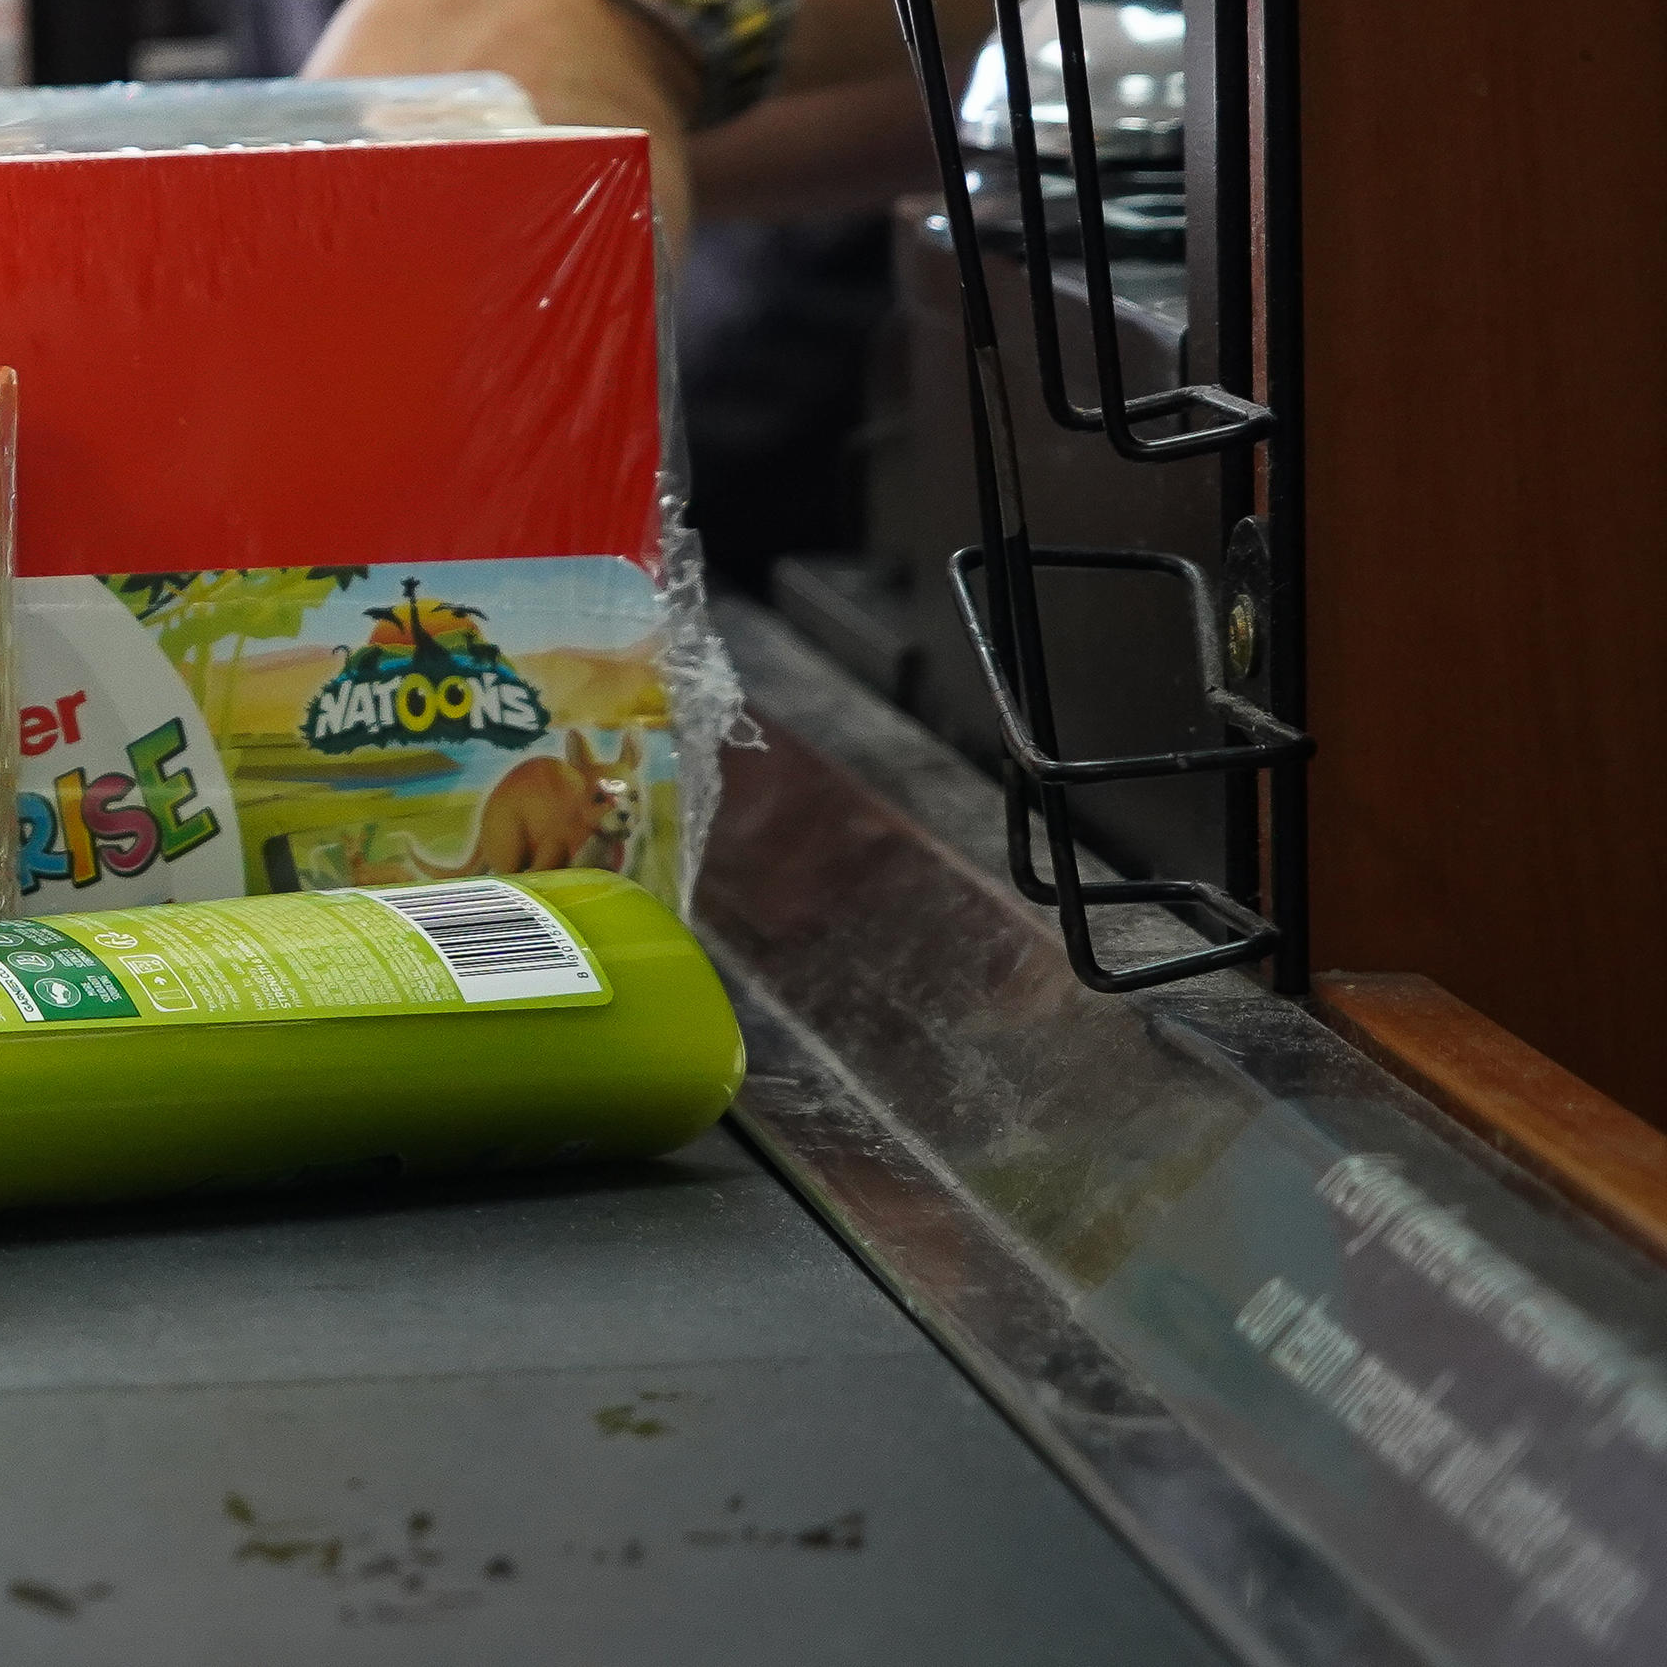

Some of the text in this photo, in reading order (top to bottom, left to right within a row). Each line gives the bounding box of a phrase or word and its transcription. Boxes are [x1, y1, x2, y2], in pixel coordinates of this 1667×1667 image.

[313, 673, 539, 737] NATOONS
[19, 690, 87, 757] er
[16, 717, 221, 896] RISE
[250, 957, 263, 965] &
[576, 971, 589, 979] 8
[4, 978, 34, 1013] GARNIER
[242, 978, 254, 988] to
[250, 991, 266, 1010] How
[257, 964, 292, 1010] STRENGTH
